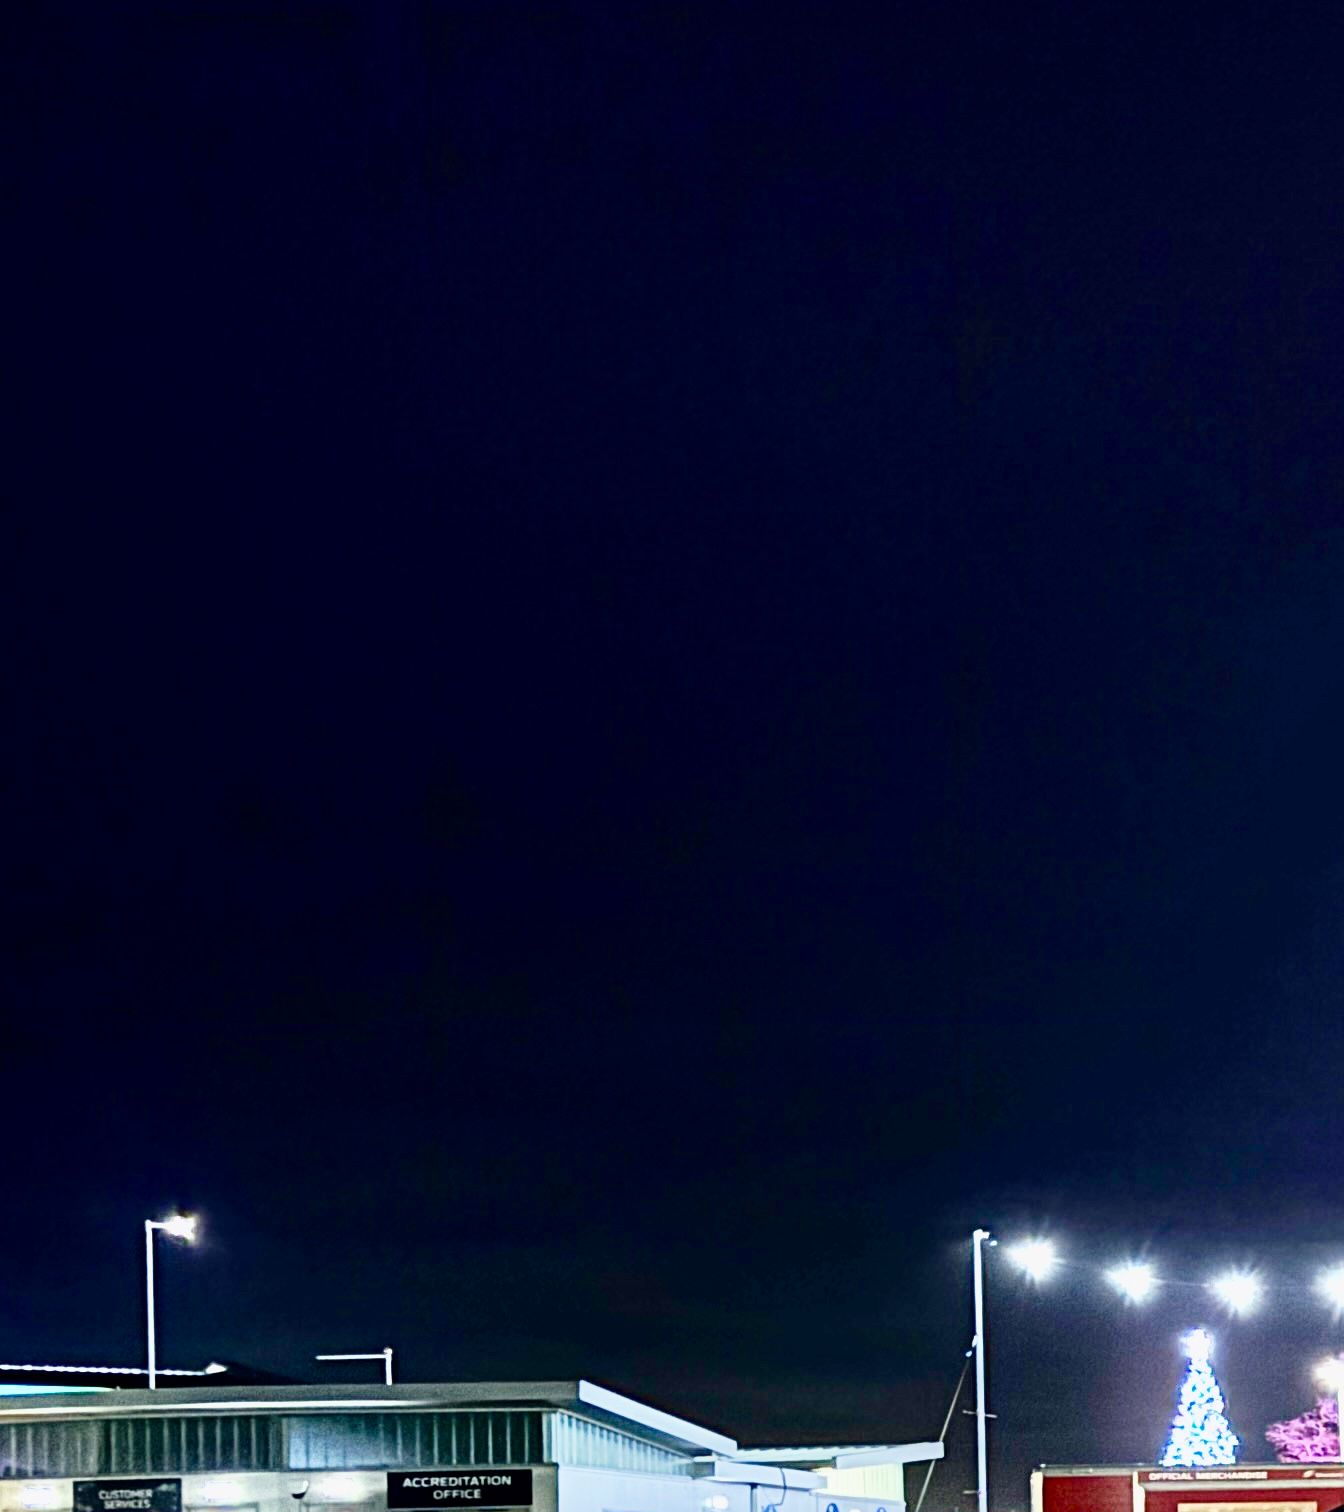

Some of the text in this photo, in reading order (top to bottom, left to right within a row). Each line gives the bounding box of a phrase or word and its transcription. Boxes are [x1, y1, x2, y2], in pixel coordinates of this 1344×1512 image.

[1149, 1471, 1268, 1480] OFFICIAL MERCHANDISE
[402, 1475, 511, 1488] ACCREDITATION
[98, 1489, 153, 1500] CUSTOMER
[433, 1489, 482, 1500] OFFICE
[104, 1499, 151, 1509] SERVICES
